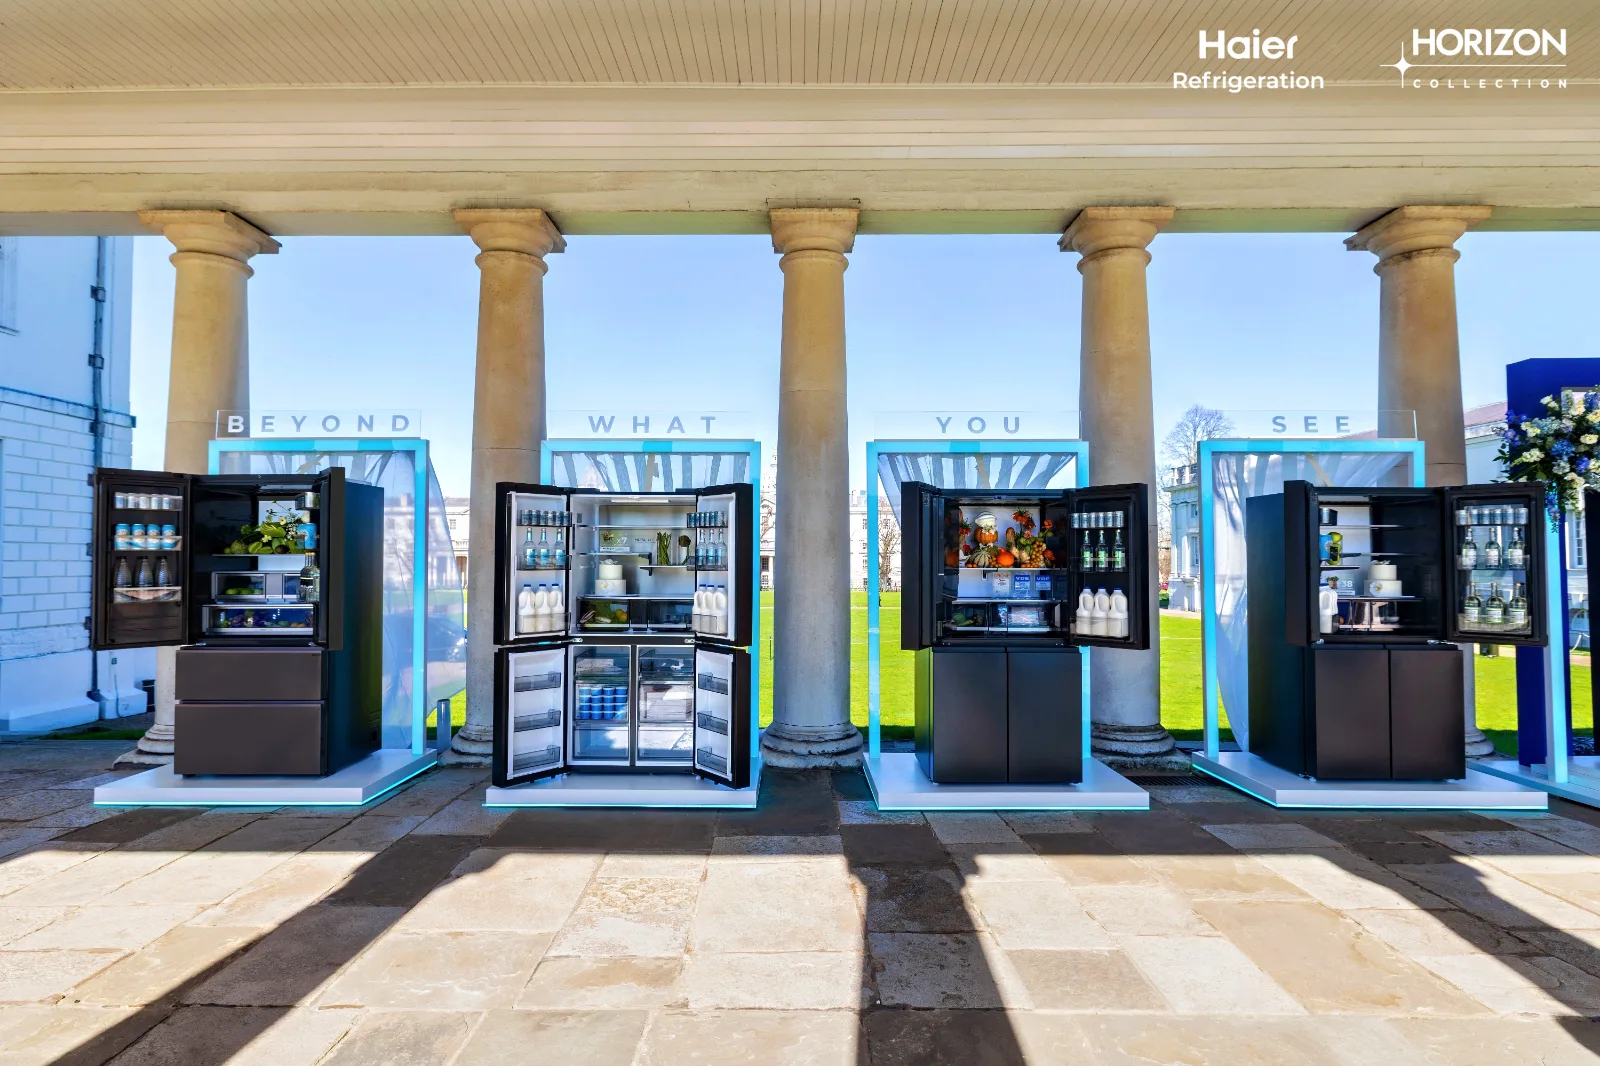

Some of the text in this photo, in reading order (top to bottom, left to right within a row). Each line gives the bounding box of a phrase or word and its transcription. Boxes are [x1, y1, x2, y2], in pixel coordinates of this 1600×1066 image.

[227, 415, 410, 433] BEYOND
[588, 415, 717, 434] WHAT
[935, 416, 1020, 434] YOU
[1271, 415, 1351, 434] SEE
